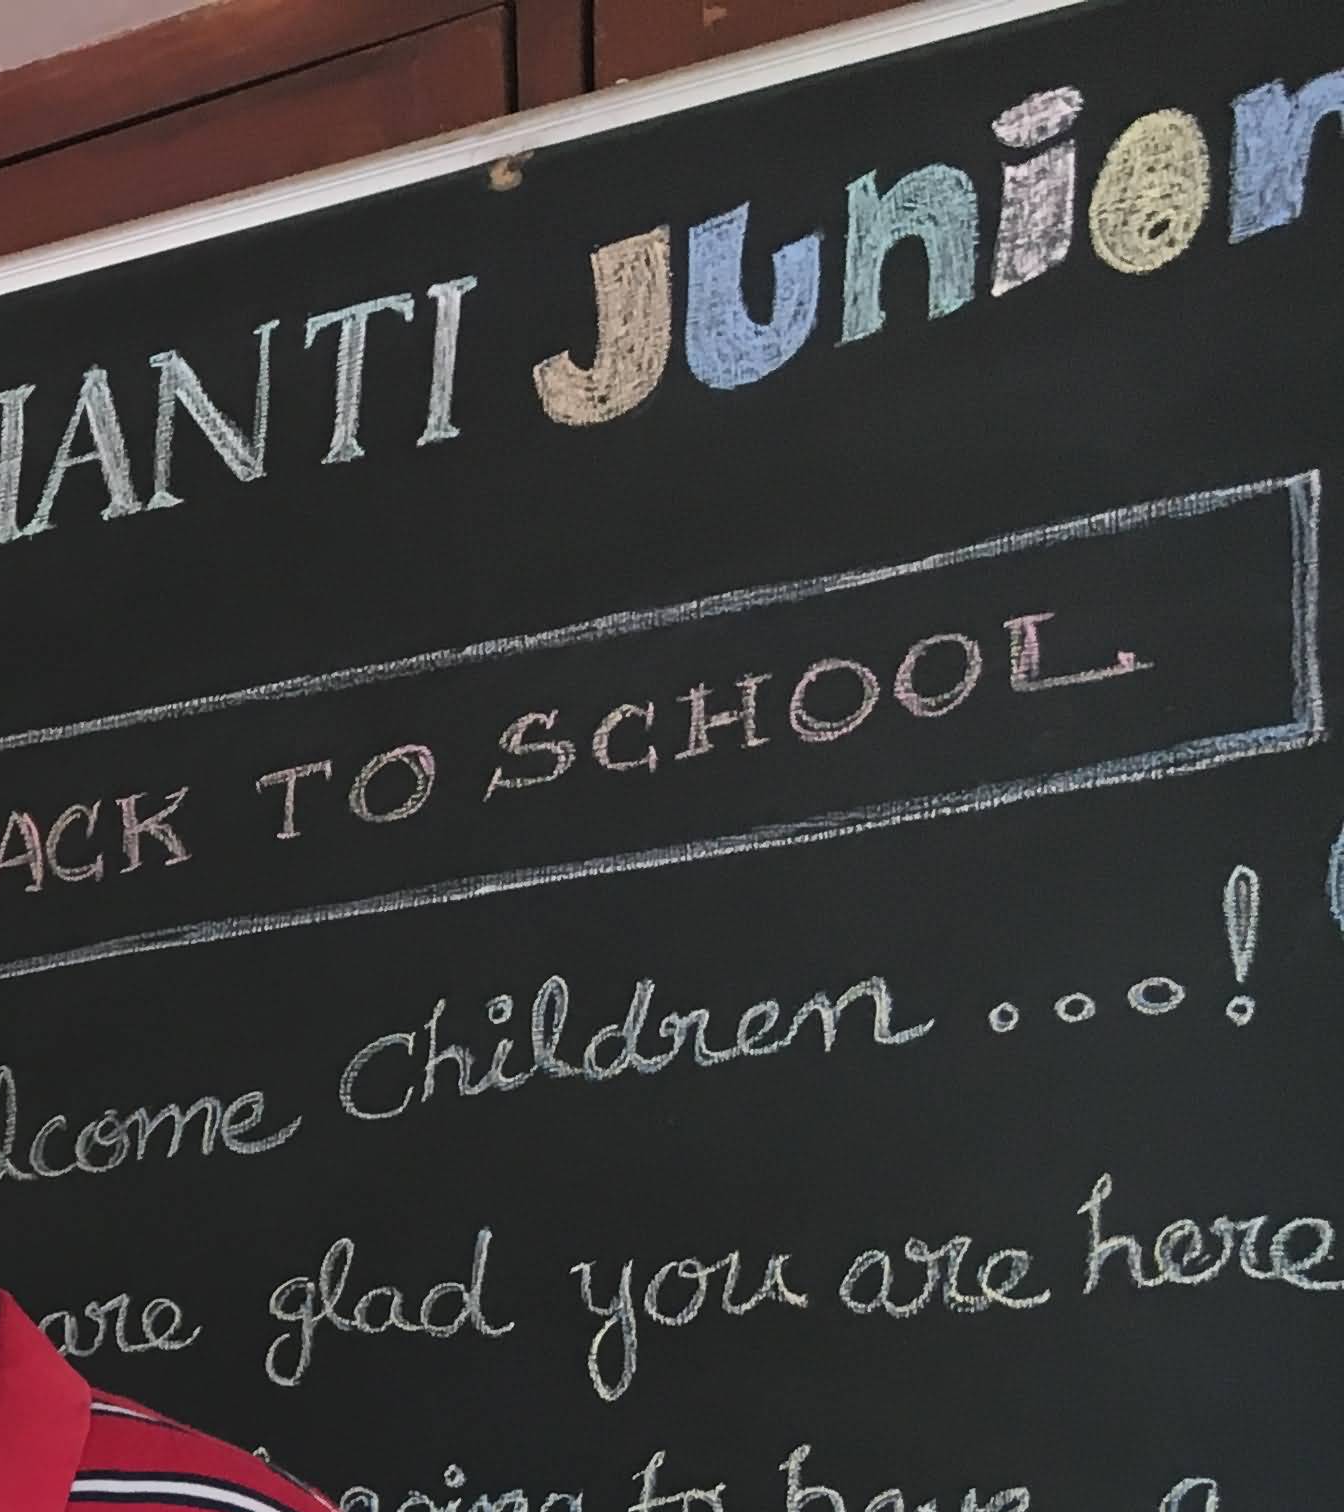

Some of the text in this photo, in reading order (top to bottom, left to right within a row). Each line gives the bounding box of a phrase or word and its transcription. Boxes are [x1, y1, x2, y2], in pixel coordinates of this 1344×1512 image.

[255, 744, 436, 840] TO
[483, 611, 1155, 802] SCHOOL
[339, 975, 935, 1120] Children
[39, 1172, 1344, 1401] are glad you are here
